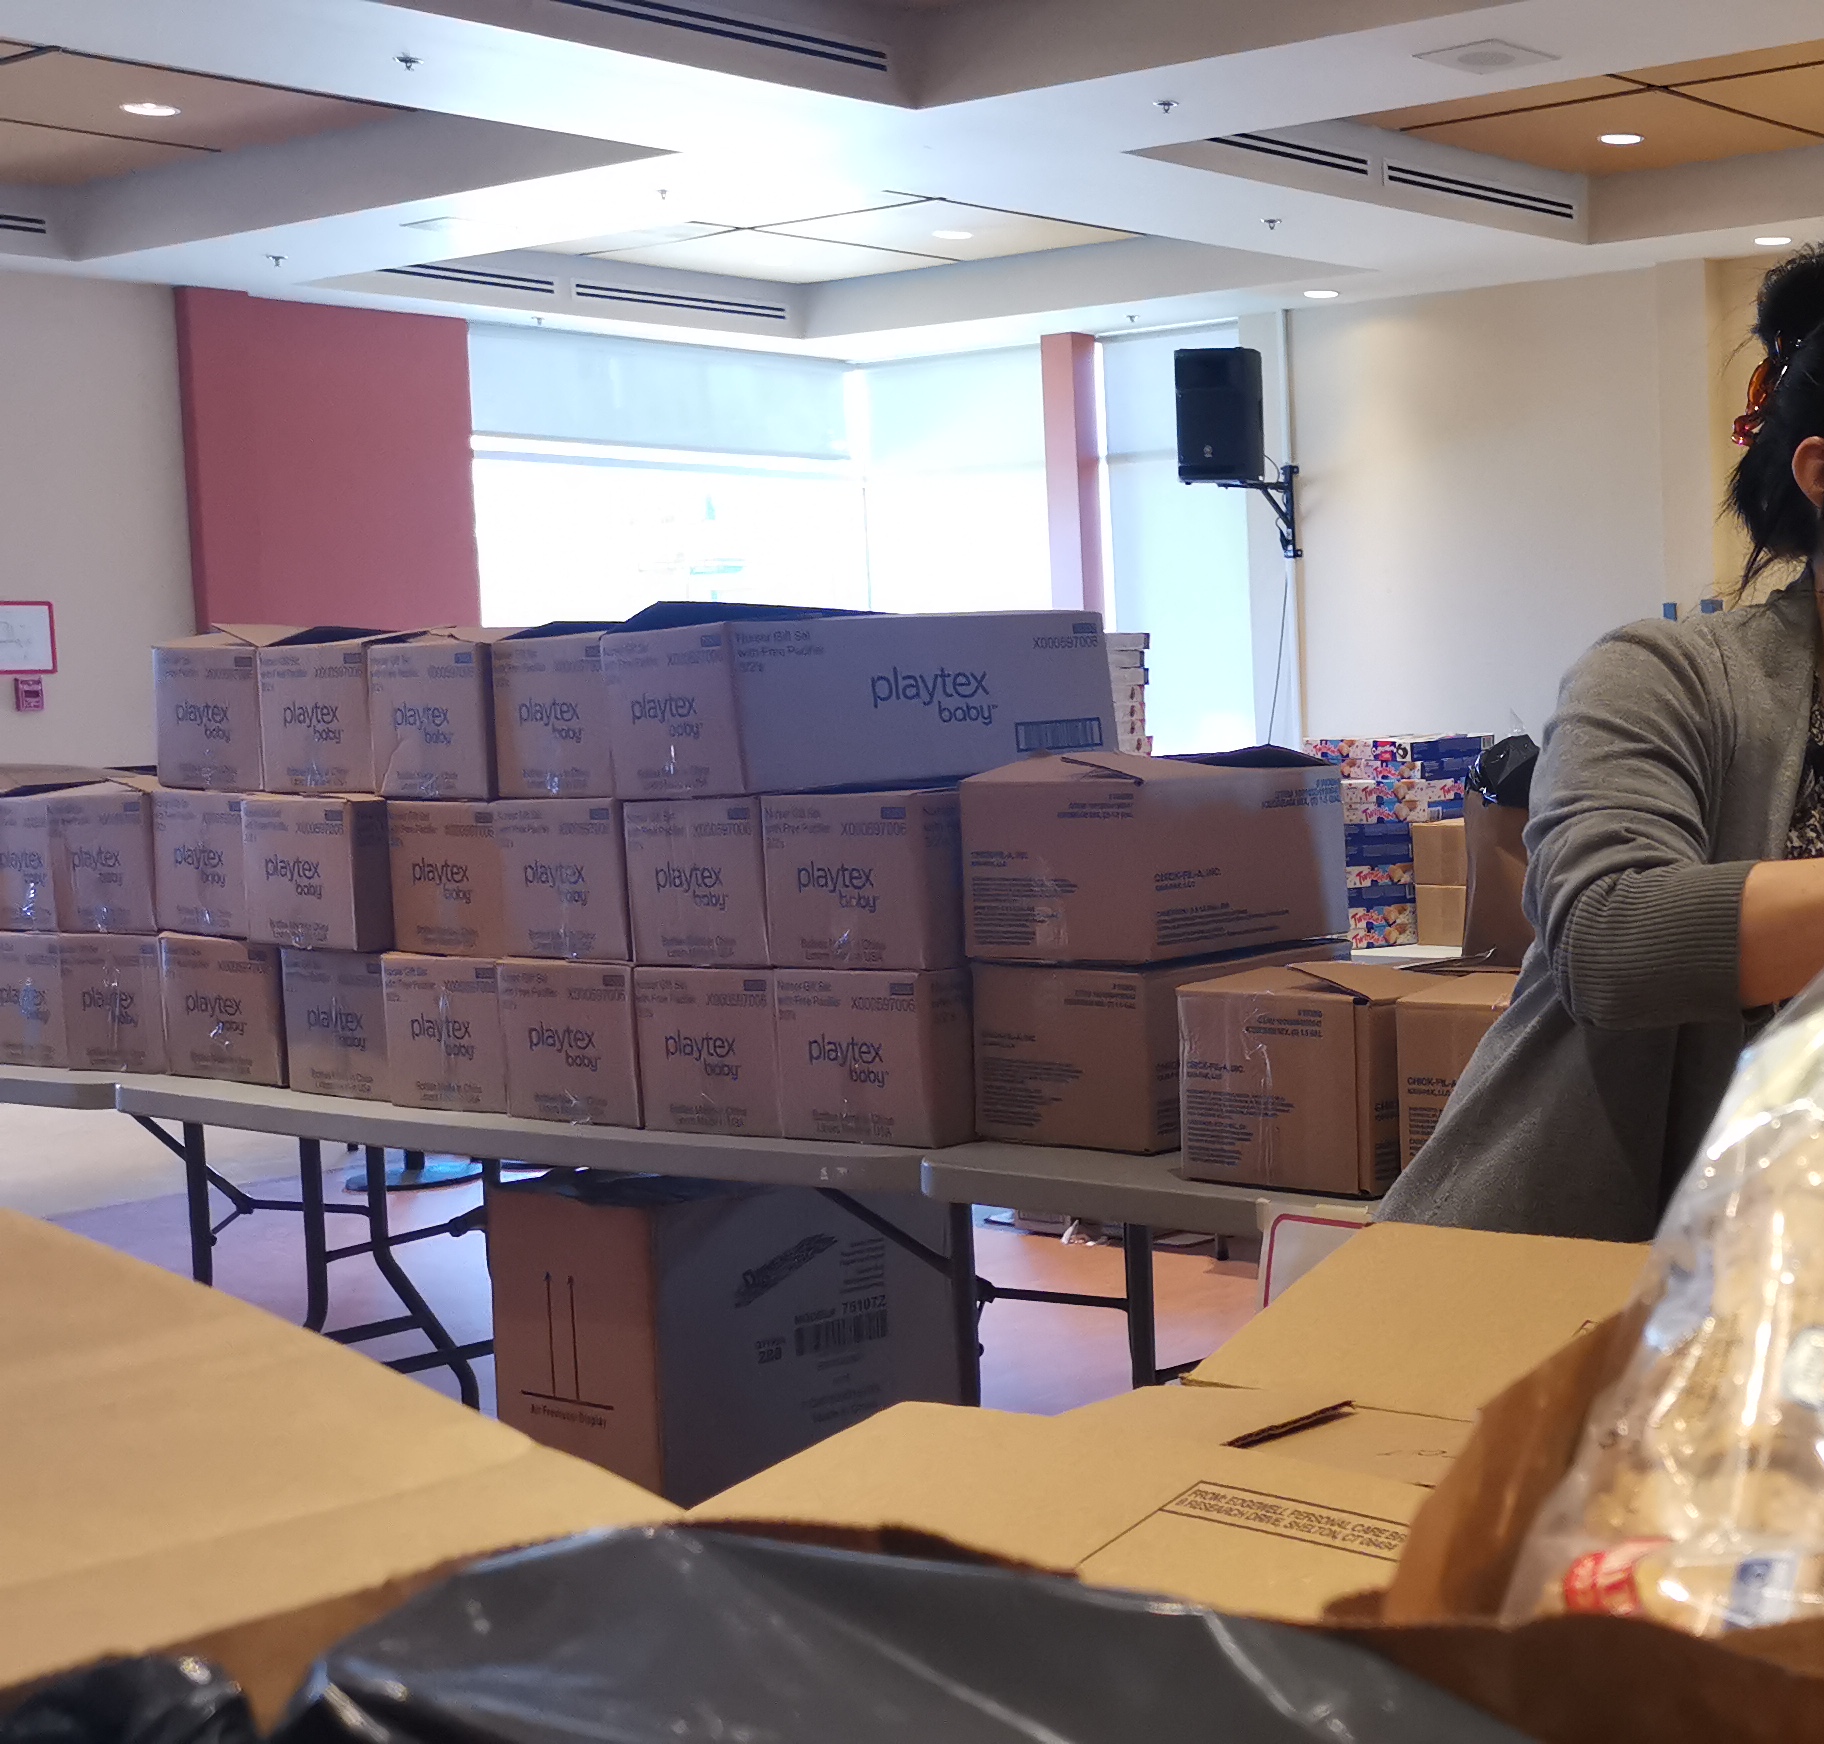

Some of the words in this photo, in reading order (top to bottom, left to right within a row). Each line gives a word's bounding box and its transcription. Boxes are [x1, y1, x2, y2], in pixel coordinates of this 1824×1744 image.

[871, 666, 989, 708] playtex
[175, 700, 230, 726] playtex
[283, 701, 339, 728] playtex
[394, 701, 450, 731] playtex
[518, 698, 580, 726] playtex
[630, 693, 697, 724] playtex
[938, 700, 996, 726] baby
[174, 844, 224, 870] playtex
[265, 854, 320, 882] playtex
[411, 857, 470, 884] playtex
[524, 860, 585, 887] playtex
[655, 861, 723, 893] playtex
[797, 861, 874, 893] playtex
[185, 990, 242, 1019] playtex
[410, 1013, 472, 1042] playtex
[528, 1021, 596, 1051] playtex
[664, 1029, 736, 1061] playtex
[808, 1032, 883, 1067] playtex
[1351, 1523, 1390, 1538] CARE
